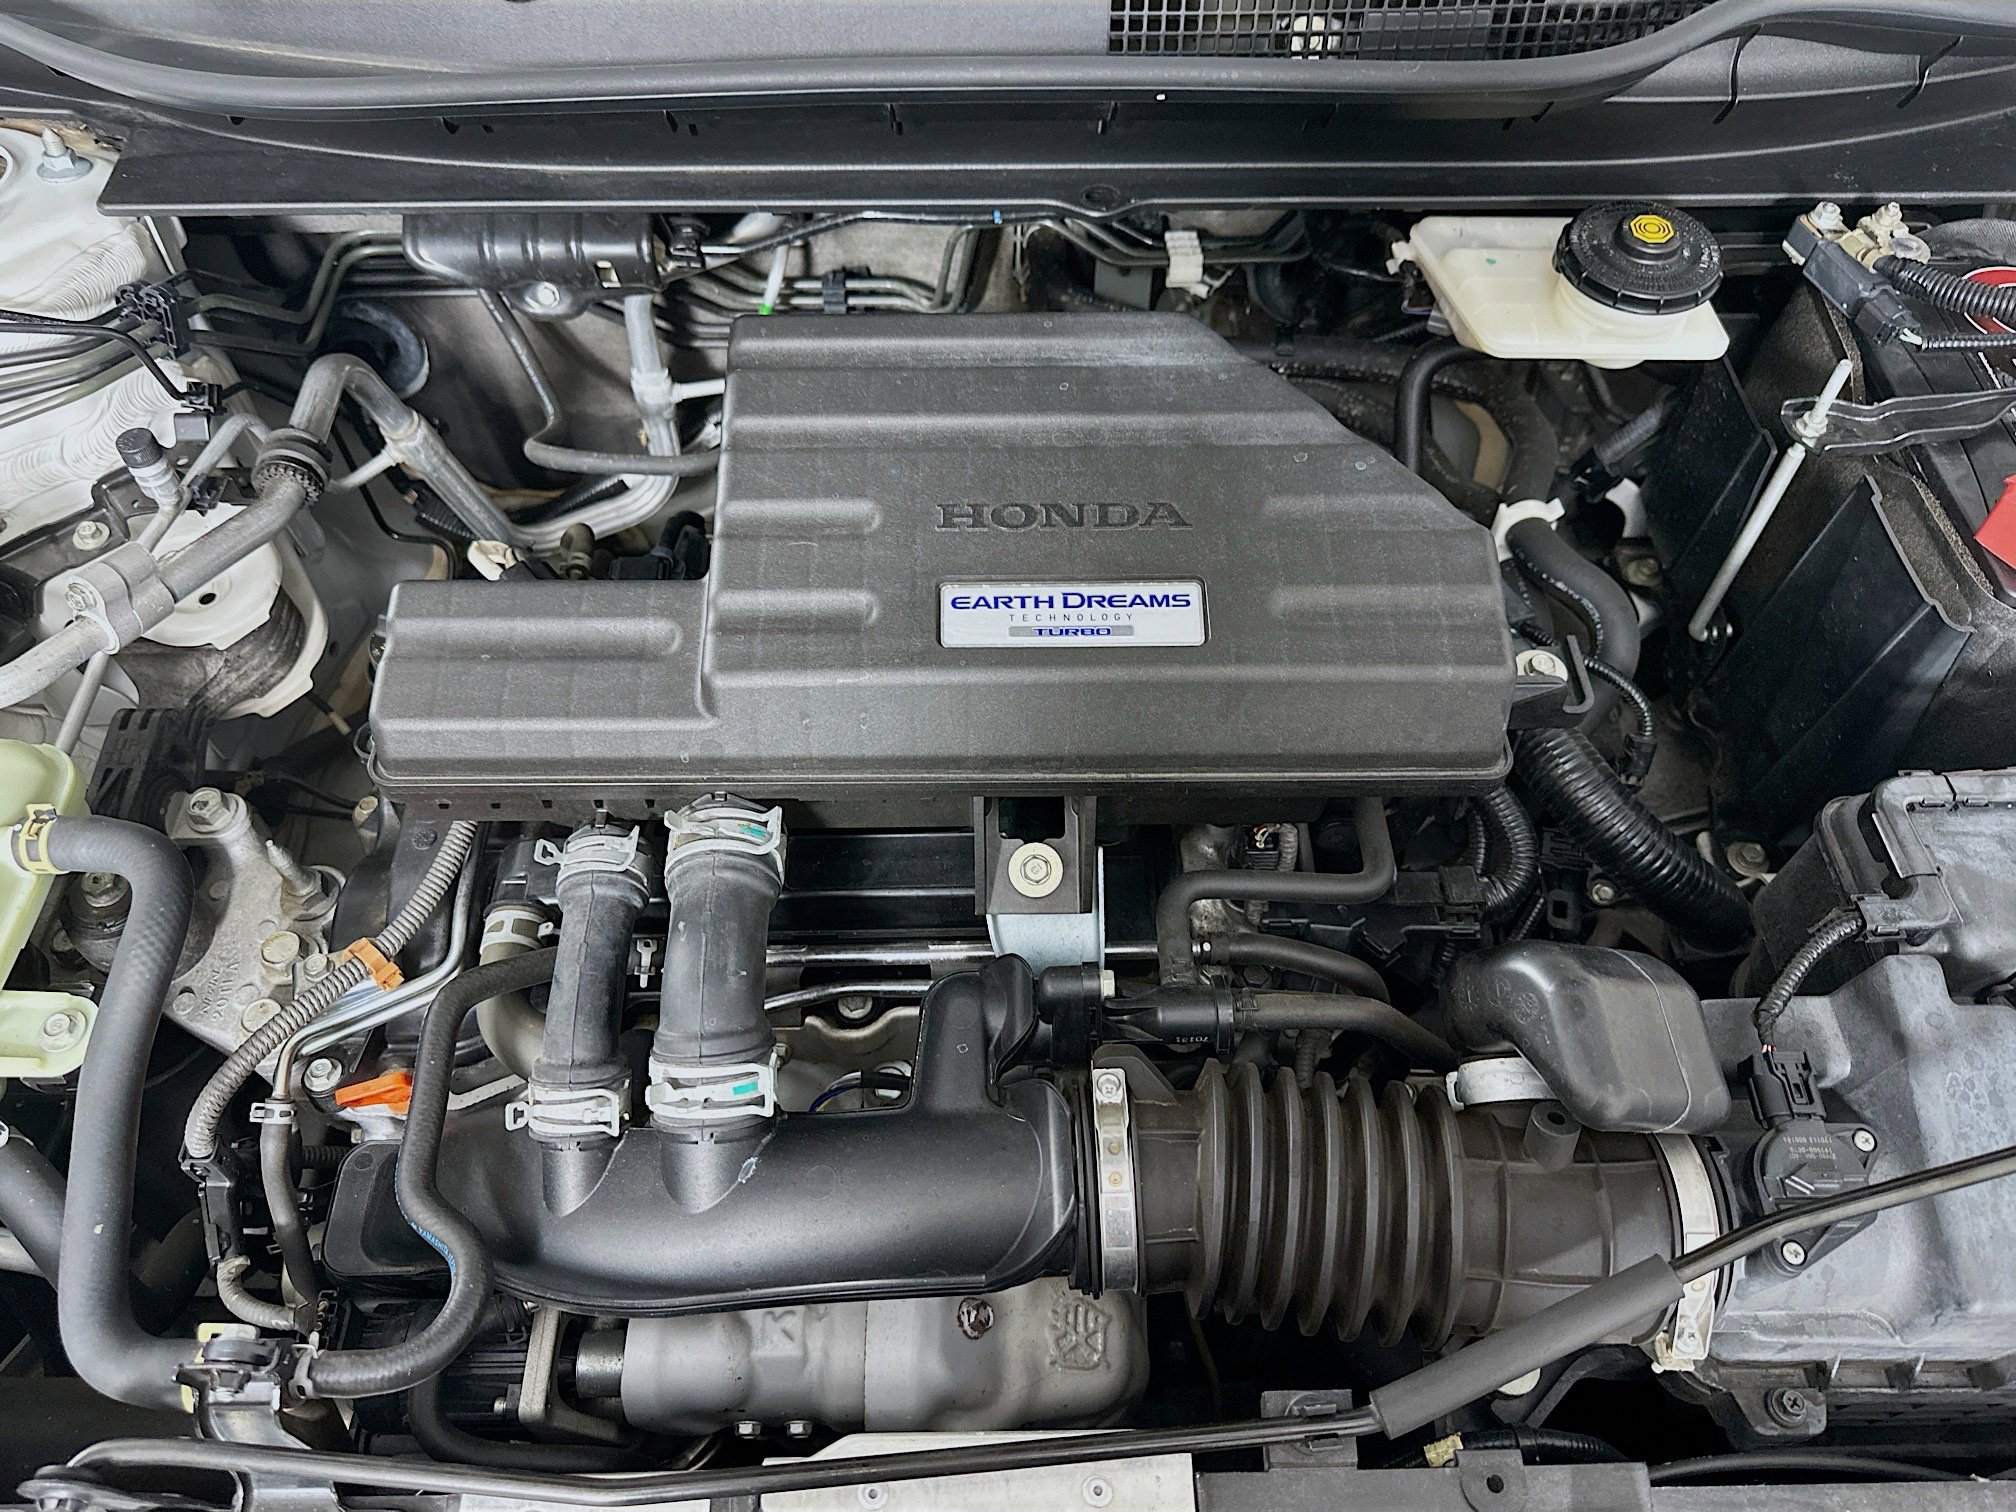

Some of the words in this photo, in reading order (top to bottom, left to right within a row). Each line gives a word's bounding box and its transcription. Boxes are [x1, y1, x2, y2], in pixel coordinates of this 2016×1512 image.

[935, 502, 1194, 531] HONDA
[951, 596, 1055, 610] EARTH
[1062, 592, 1192, 609] DREAMS
[1009, 613, 1134, 622] TECHNOLOGY
[1033, 627, 1112, 637] TURBO
